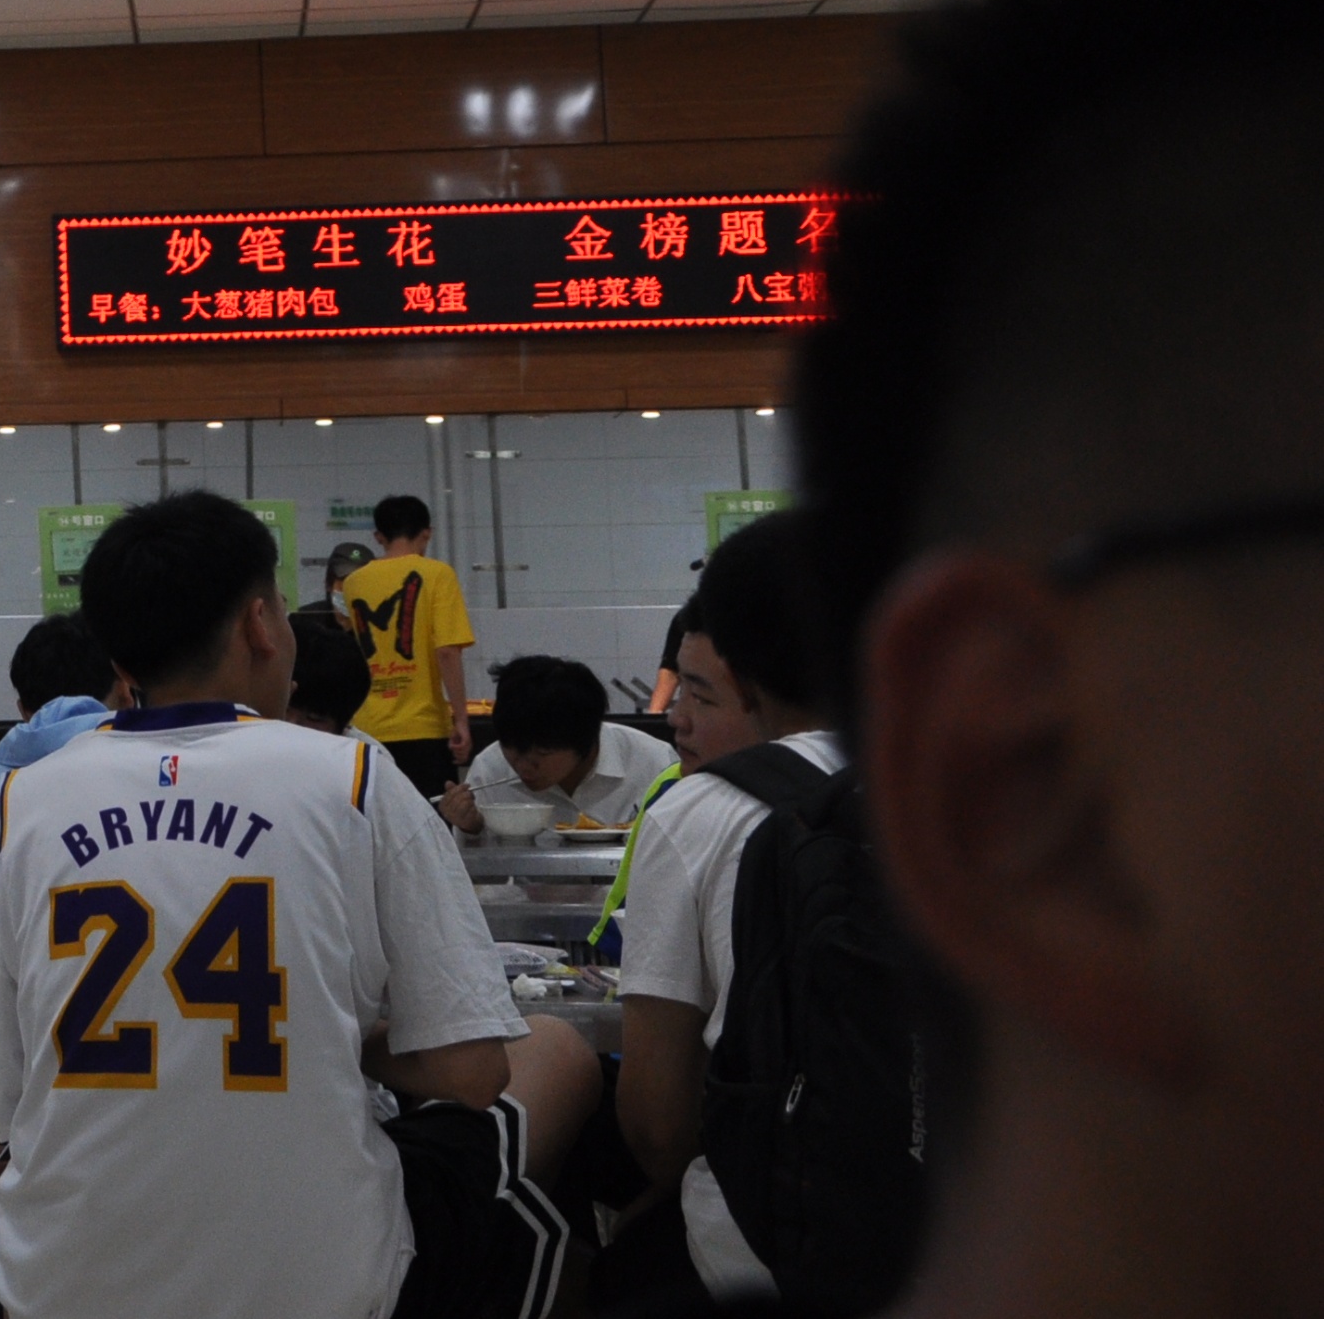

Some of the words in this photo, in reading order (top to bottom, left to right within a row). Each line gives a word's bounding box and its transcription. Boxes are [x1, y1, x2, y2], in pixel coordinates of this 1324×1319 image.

[165, 220, 436, 275] 妙笔生花
[403, 282, 468, 315] 鸡蛋
[532, 275, 663, 309] 三鲜菜卷
[61, 798, 273, 868] BRYANT
[49, 876, 288, 1092] 24
